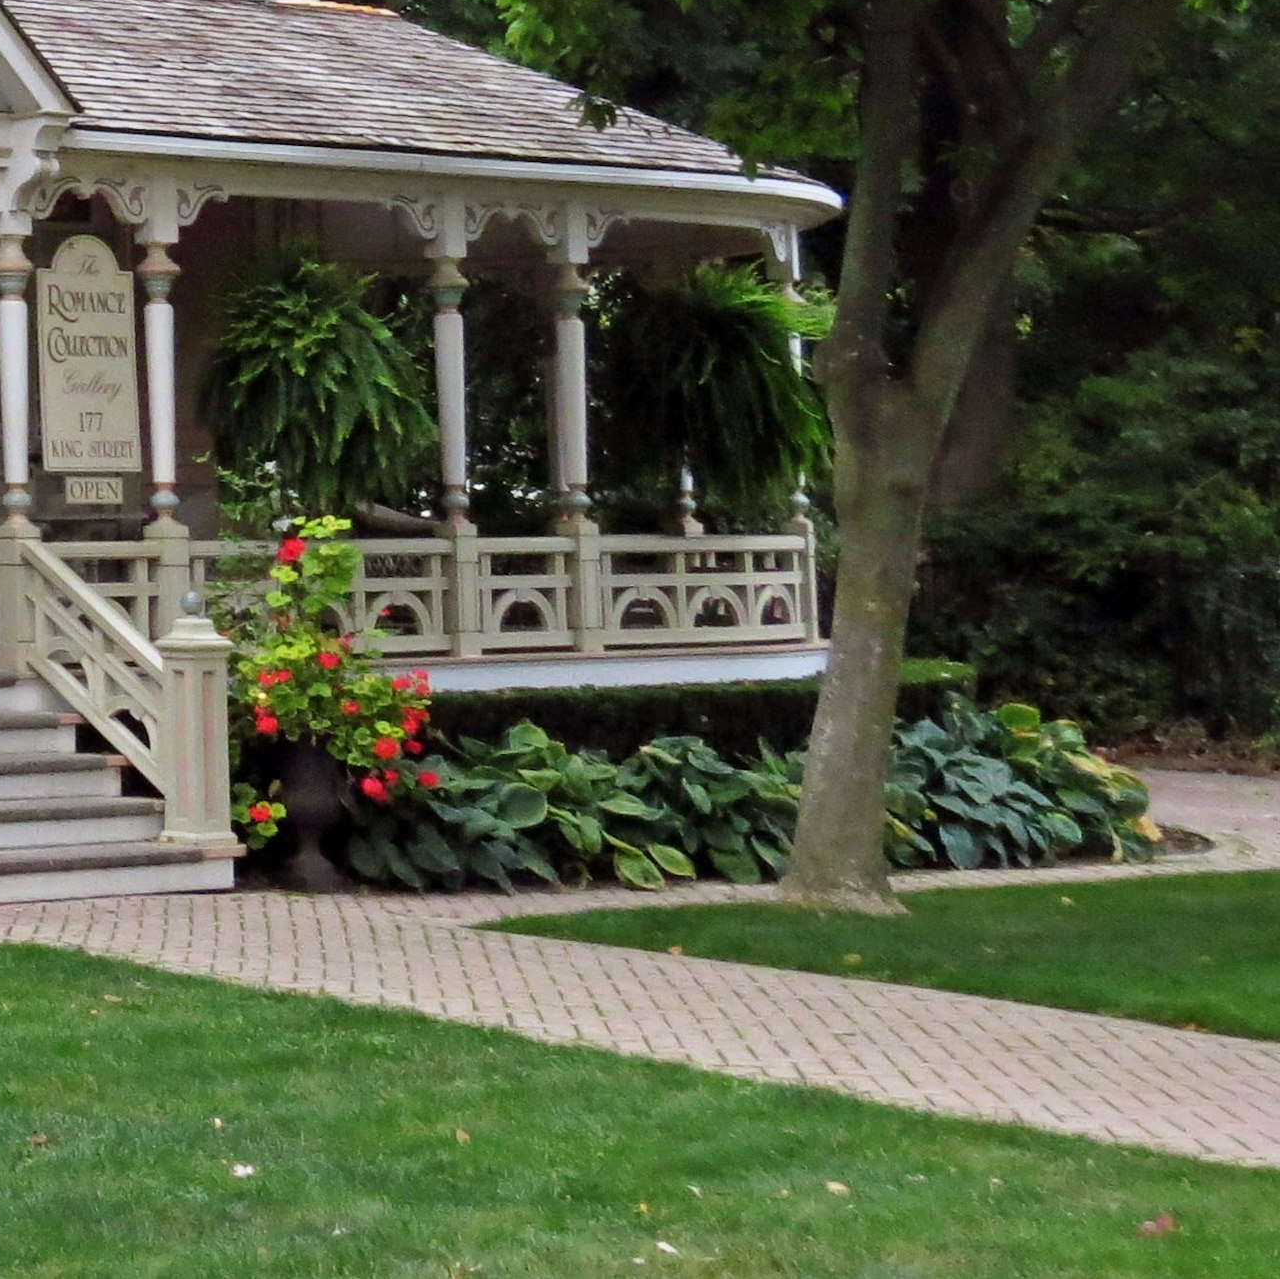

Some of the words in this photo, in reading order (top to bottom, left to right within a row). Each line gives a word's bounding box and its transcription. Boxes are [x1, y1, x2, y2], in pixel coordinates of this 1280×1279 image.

[47, 284, 126, 323] ROMANCE
[47, 327, 128, 363] COLLECTION
[79, 411, 104, 433] 177
[51, 440, 83, 459] KING
[87, 441, 135, 460] STREET
[70, 480, 119, 500] OPEN
